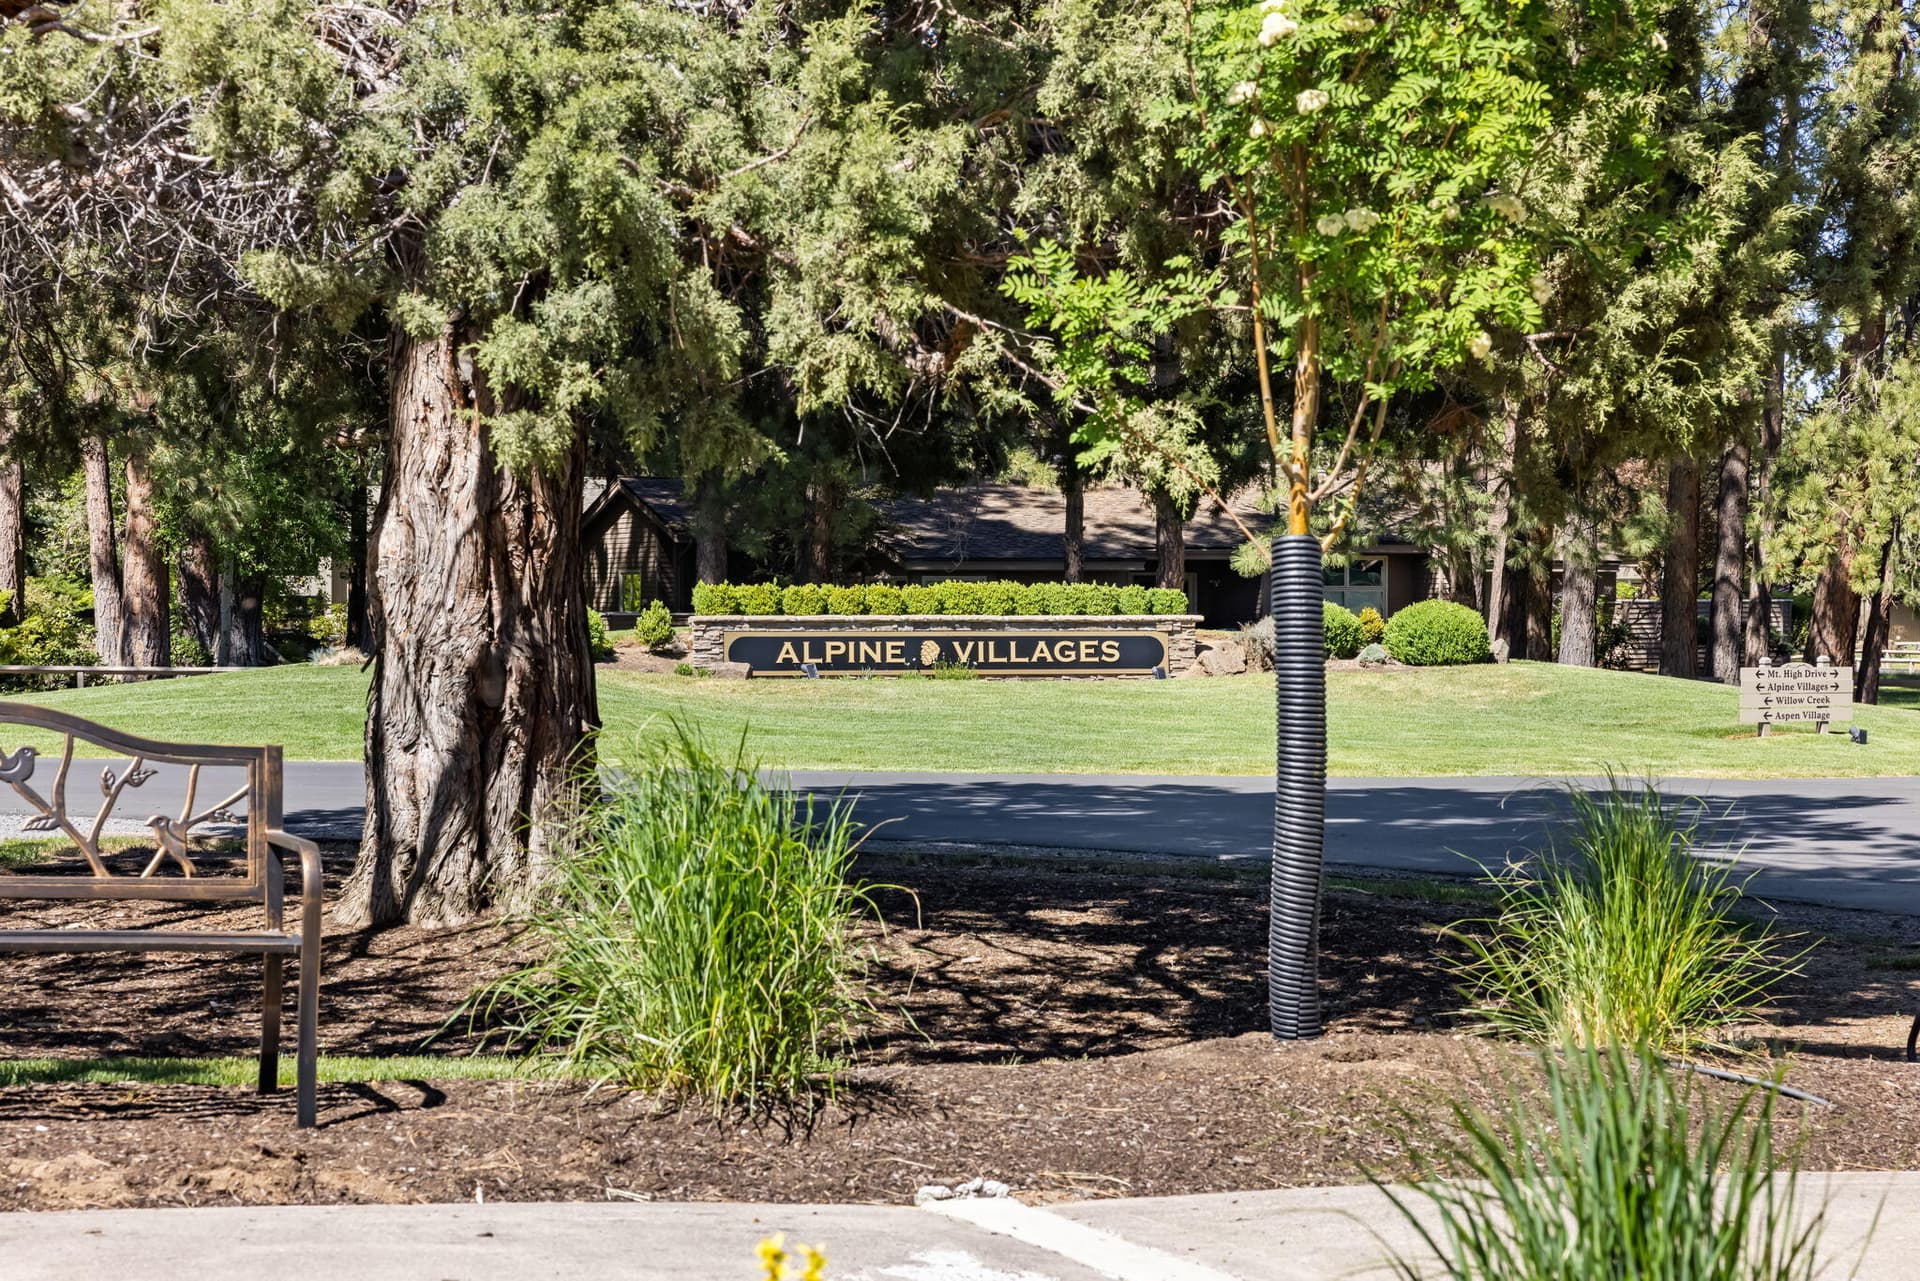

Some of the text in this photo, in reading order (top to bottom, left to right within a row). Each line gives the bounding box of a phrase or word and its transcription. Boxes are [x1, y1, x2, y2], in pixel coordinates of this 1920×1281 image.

[776, 640, 1121, 664] ALPINE VILLAGES
[1767, 669, 1827, 680] Mt. High Drive
[1767, 682, 1829, 692] Alpine Villages
[1775, 695, 1831, 705] Willow Creek
[1775, 711, 1831, 722] Aspen Village
